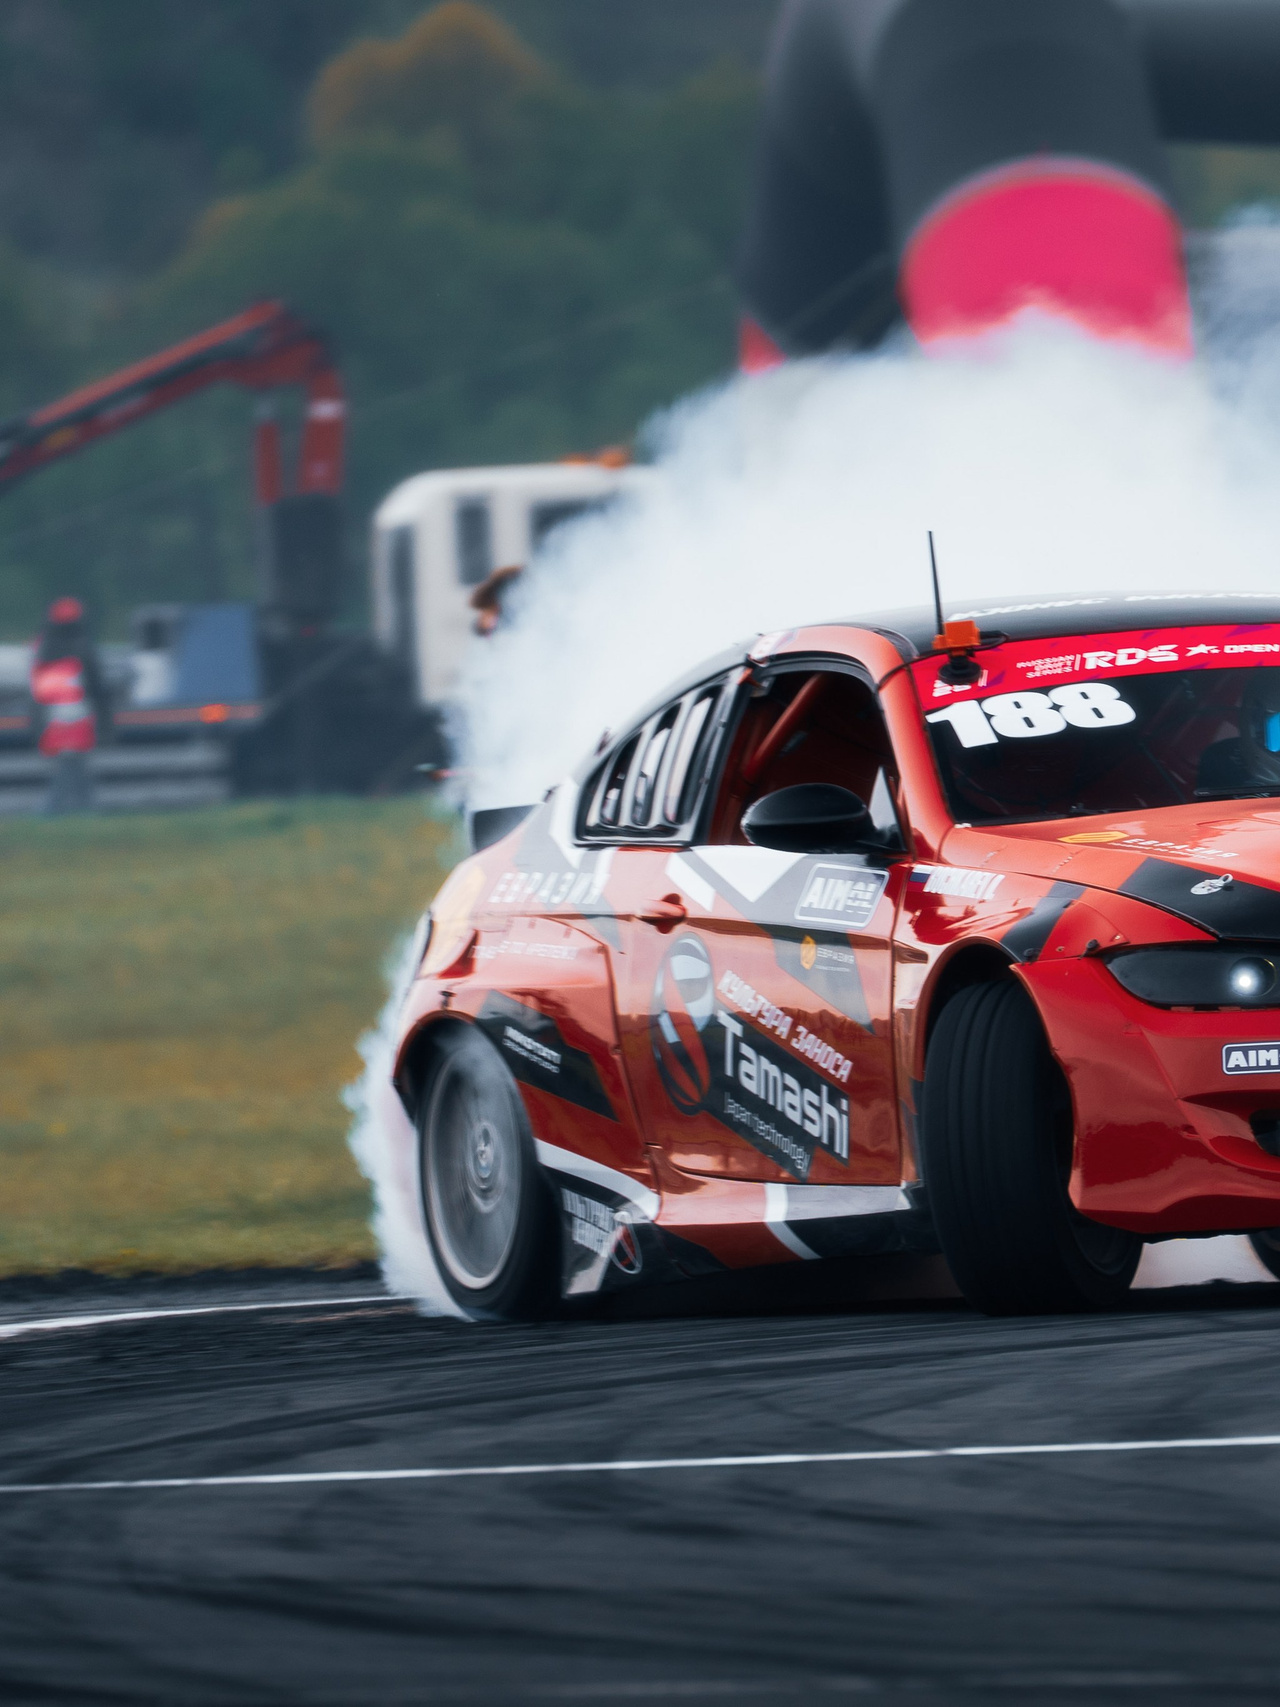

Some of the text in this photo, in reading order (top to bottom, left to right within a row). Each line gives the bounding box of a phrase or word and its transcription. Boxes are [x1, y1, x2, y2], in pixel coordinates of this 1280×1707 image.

[1026, 666, 1073, 678] SERIES
[1082, 644, 1280, 669] RDS OPEN
[925, 682, 1136, 748] 188
[717, 969, 854, 1082] КУЛЬТУРА ЗАНОСА
[717, 1009, 849, 1159] Tamashi
